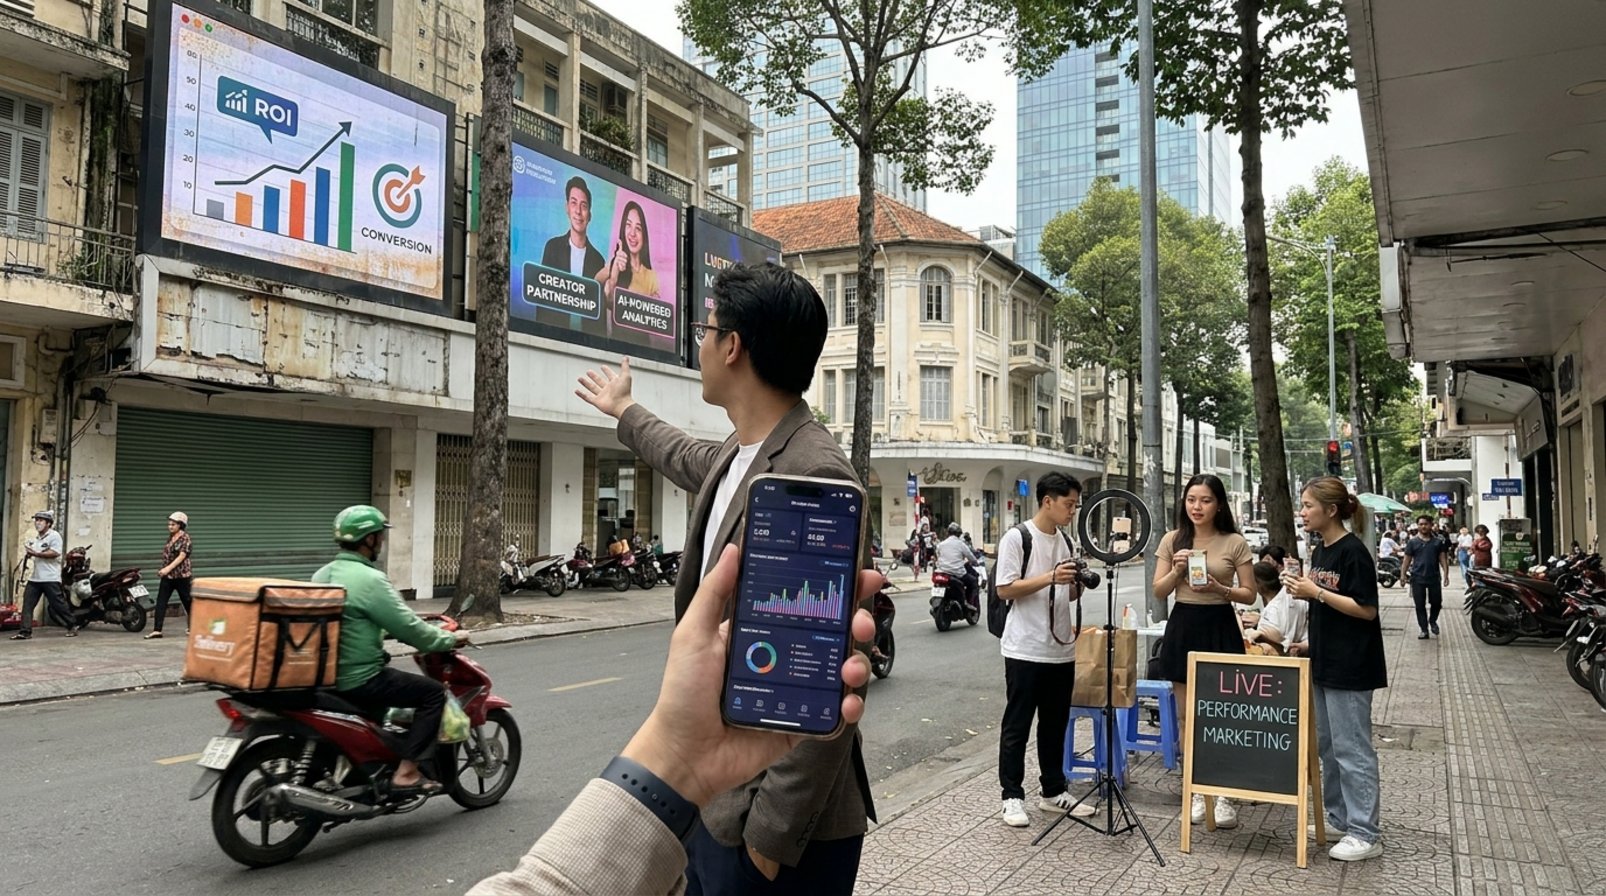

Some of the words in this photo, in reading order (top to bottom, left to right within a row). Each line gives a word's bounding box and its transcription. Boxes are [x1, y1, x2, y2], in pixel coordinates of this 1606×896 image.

[184, 103, 196, 112] 40
[255, 98, 292, 127] ROI
[183, 129, 195, 138] 30
[183, 154, 194, 163] 20
[183, 181, 192, 190] 10
[361, 226, 432, 255] CONVERSION
[538, 273, 586, 295] CREATOR
[526, 284, 597, 311] PARTNERSHIP
[1197, 699, 1298, 726] PERFORMANCE
[1202, 726, 1292, 751] MARKETING
